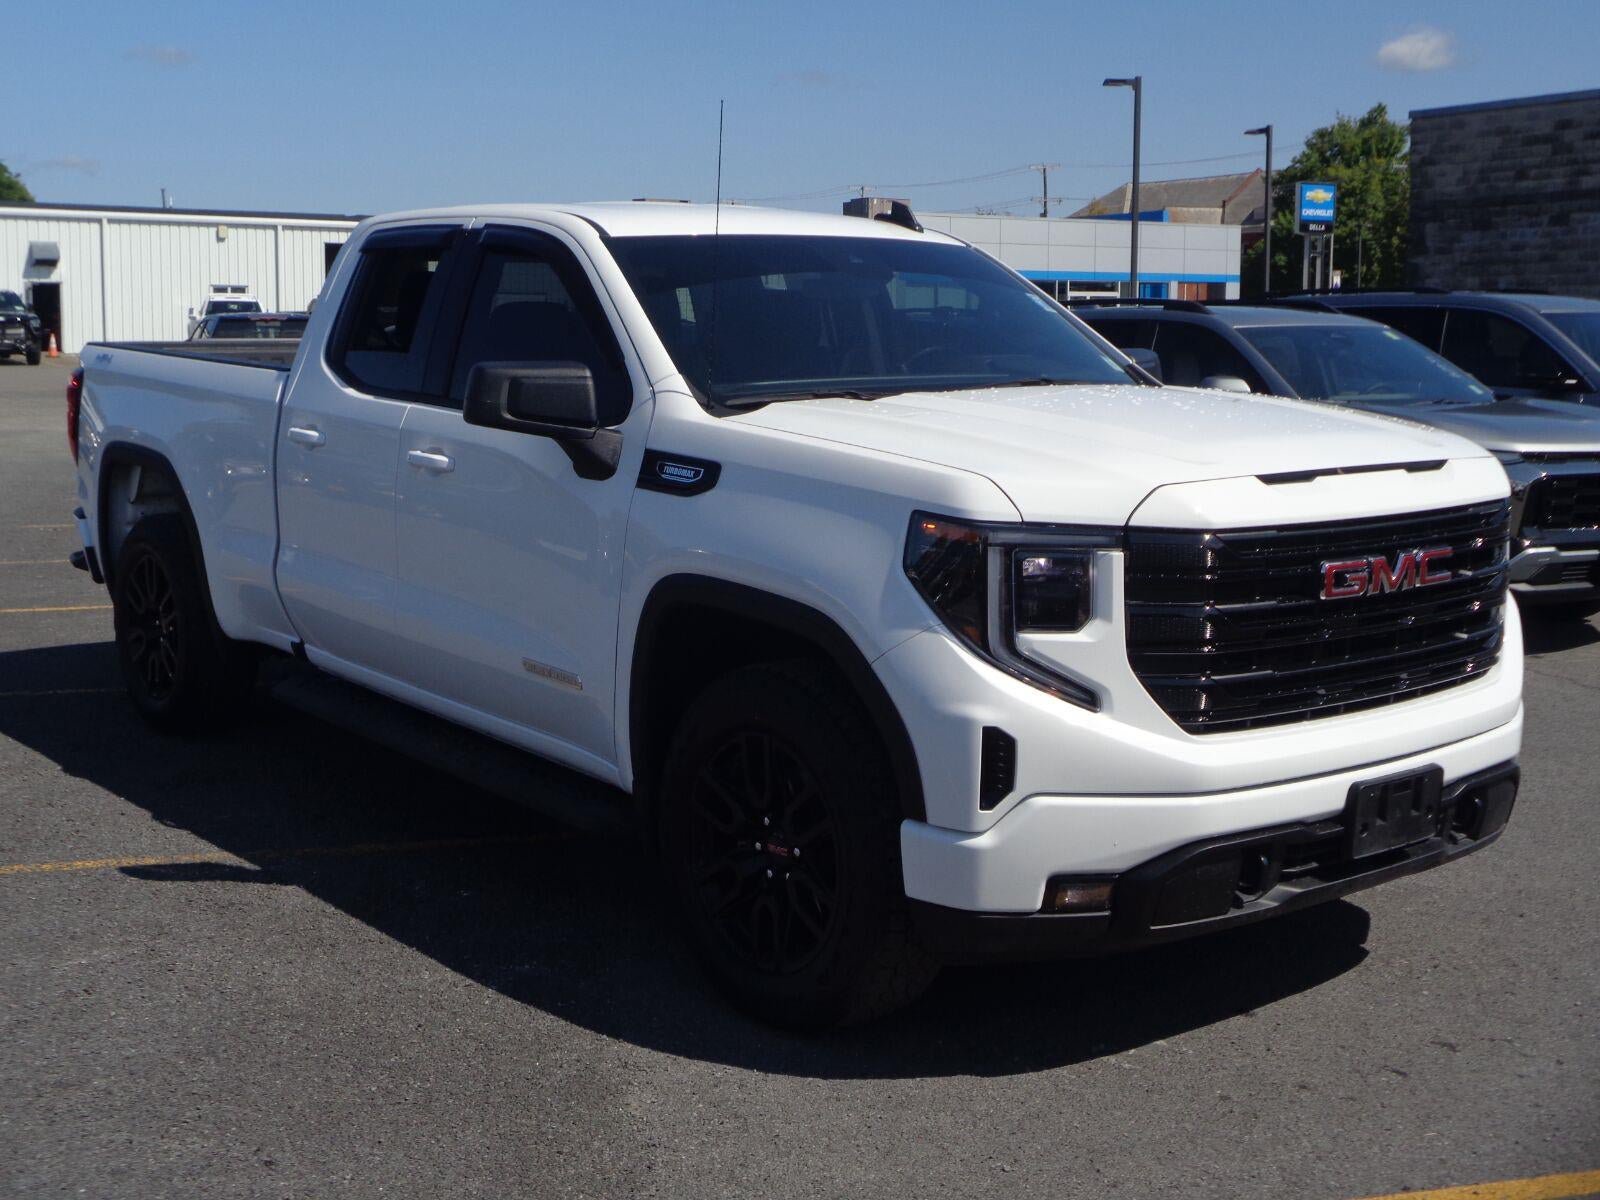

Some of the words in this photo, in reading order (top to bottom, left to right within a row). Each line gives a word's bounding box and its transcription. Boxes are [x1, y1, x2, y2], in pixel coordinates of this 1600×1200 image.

[1302, 208, 1334, 217] CHEVROLET
[663, 465, 695, 478] TURBOMAX
[1320, 547, 1454, 600] GMC
